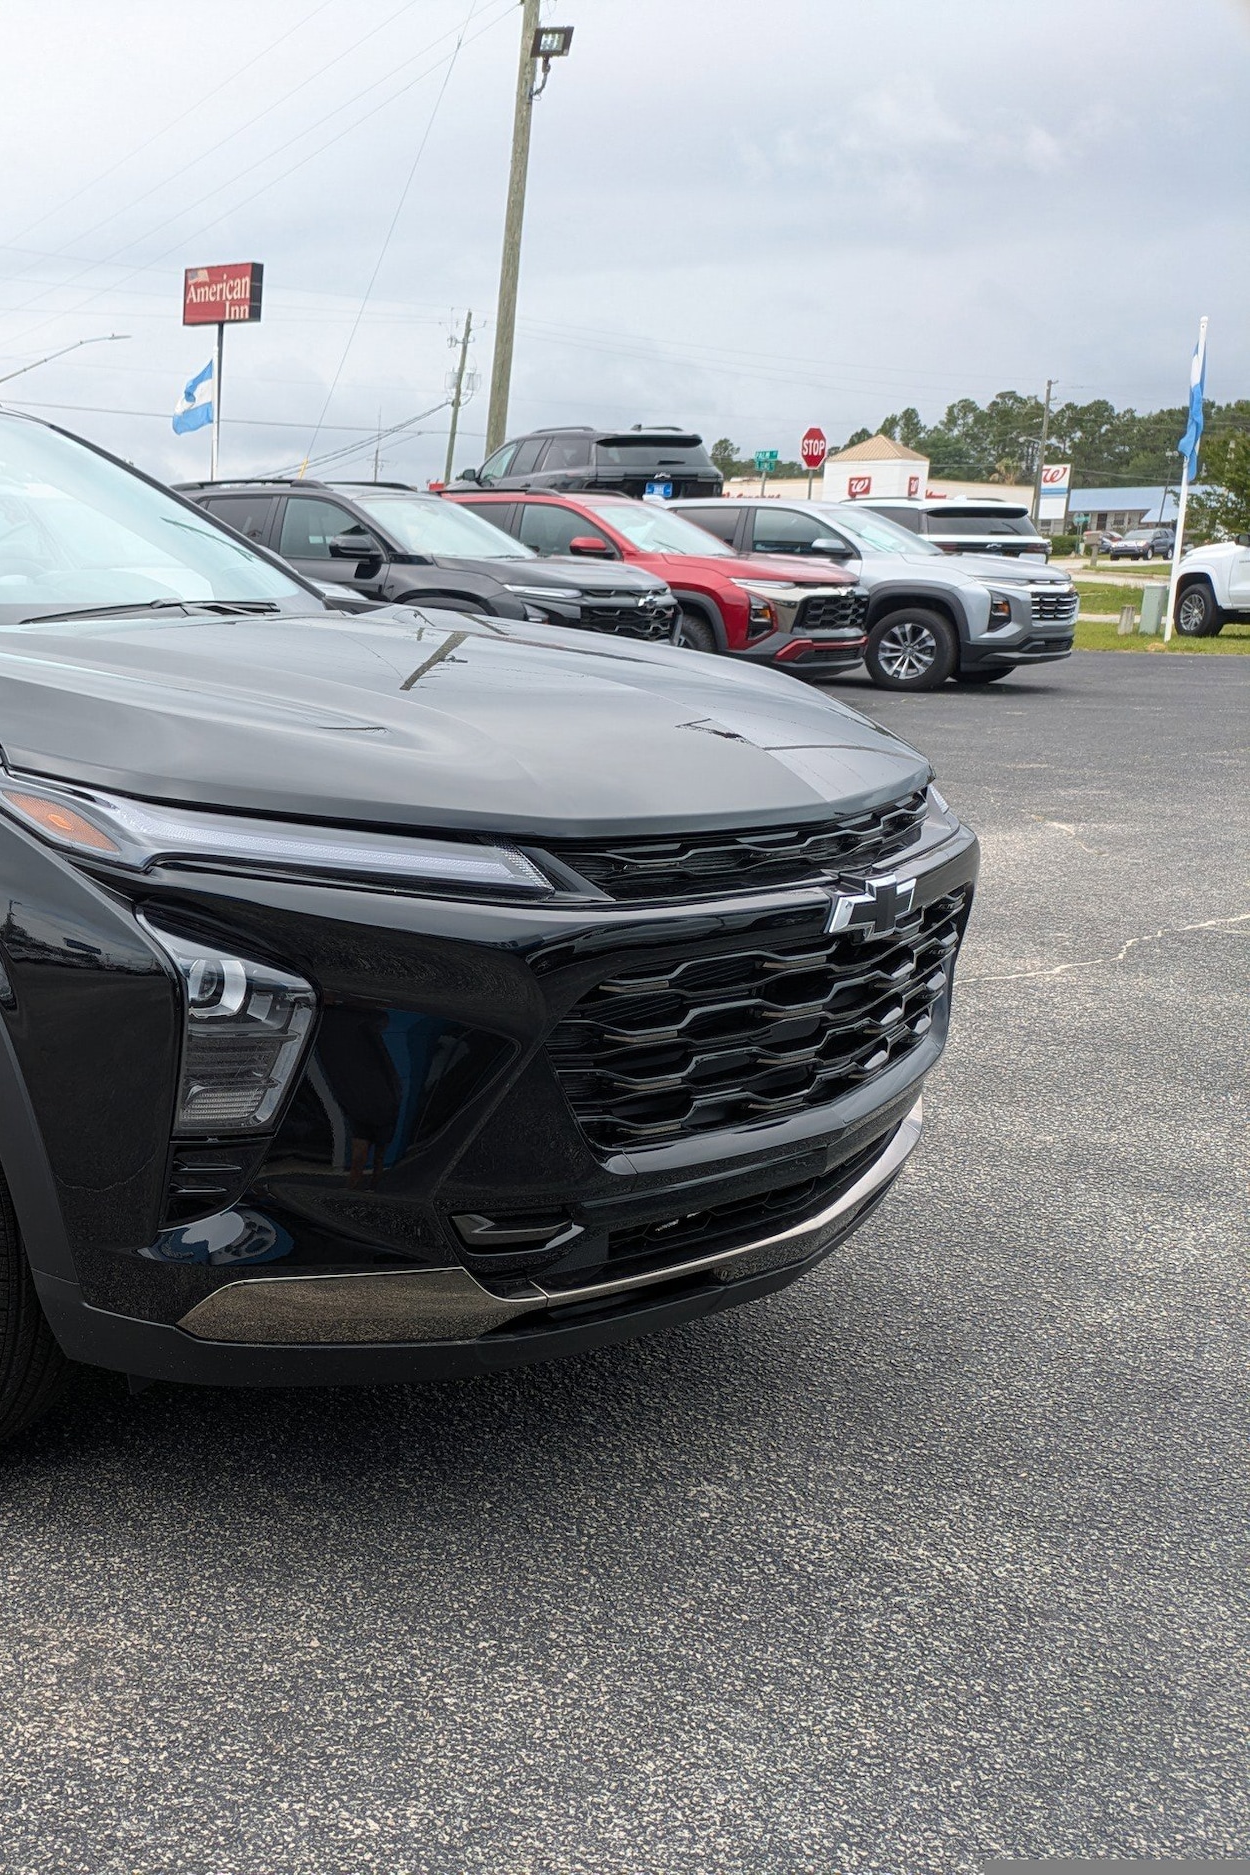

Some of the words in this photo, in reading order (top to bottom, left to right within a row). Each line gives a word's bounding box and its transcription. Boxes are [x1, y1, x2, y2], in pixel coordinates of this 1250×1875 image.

[186, 273, 250, 304] American
[225, 301, 249, 320] Inn
[802, 440, 826, 455] STOP
